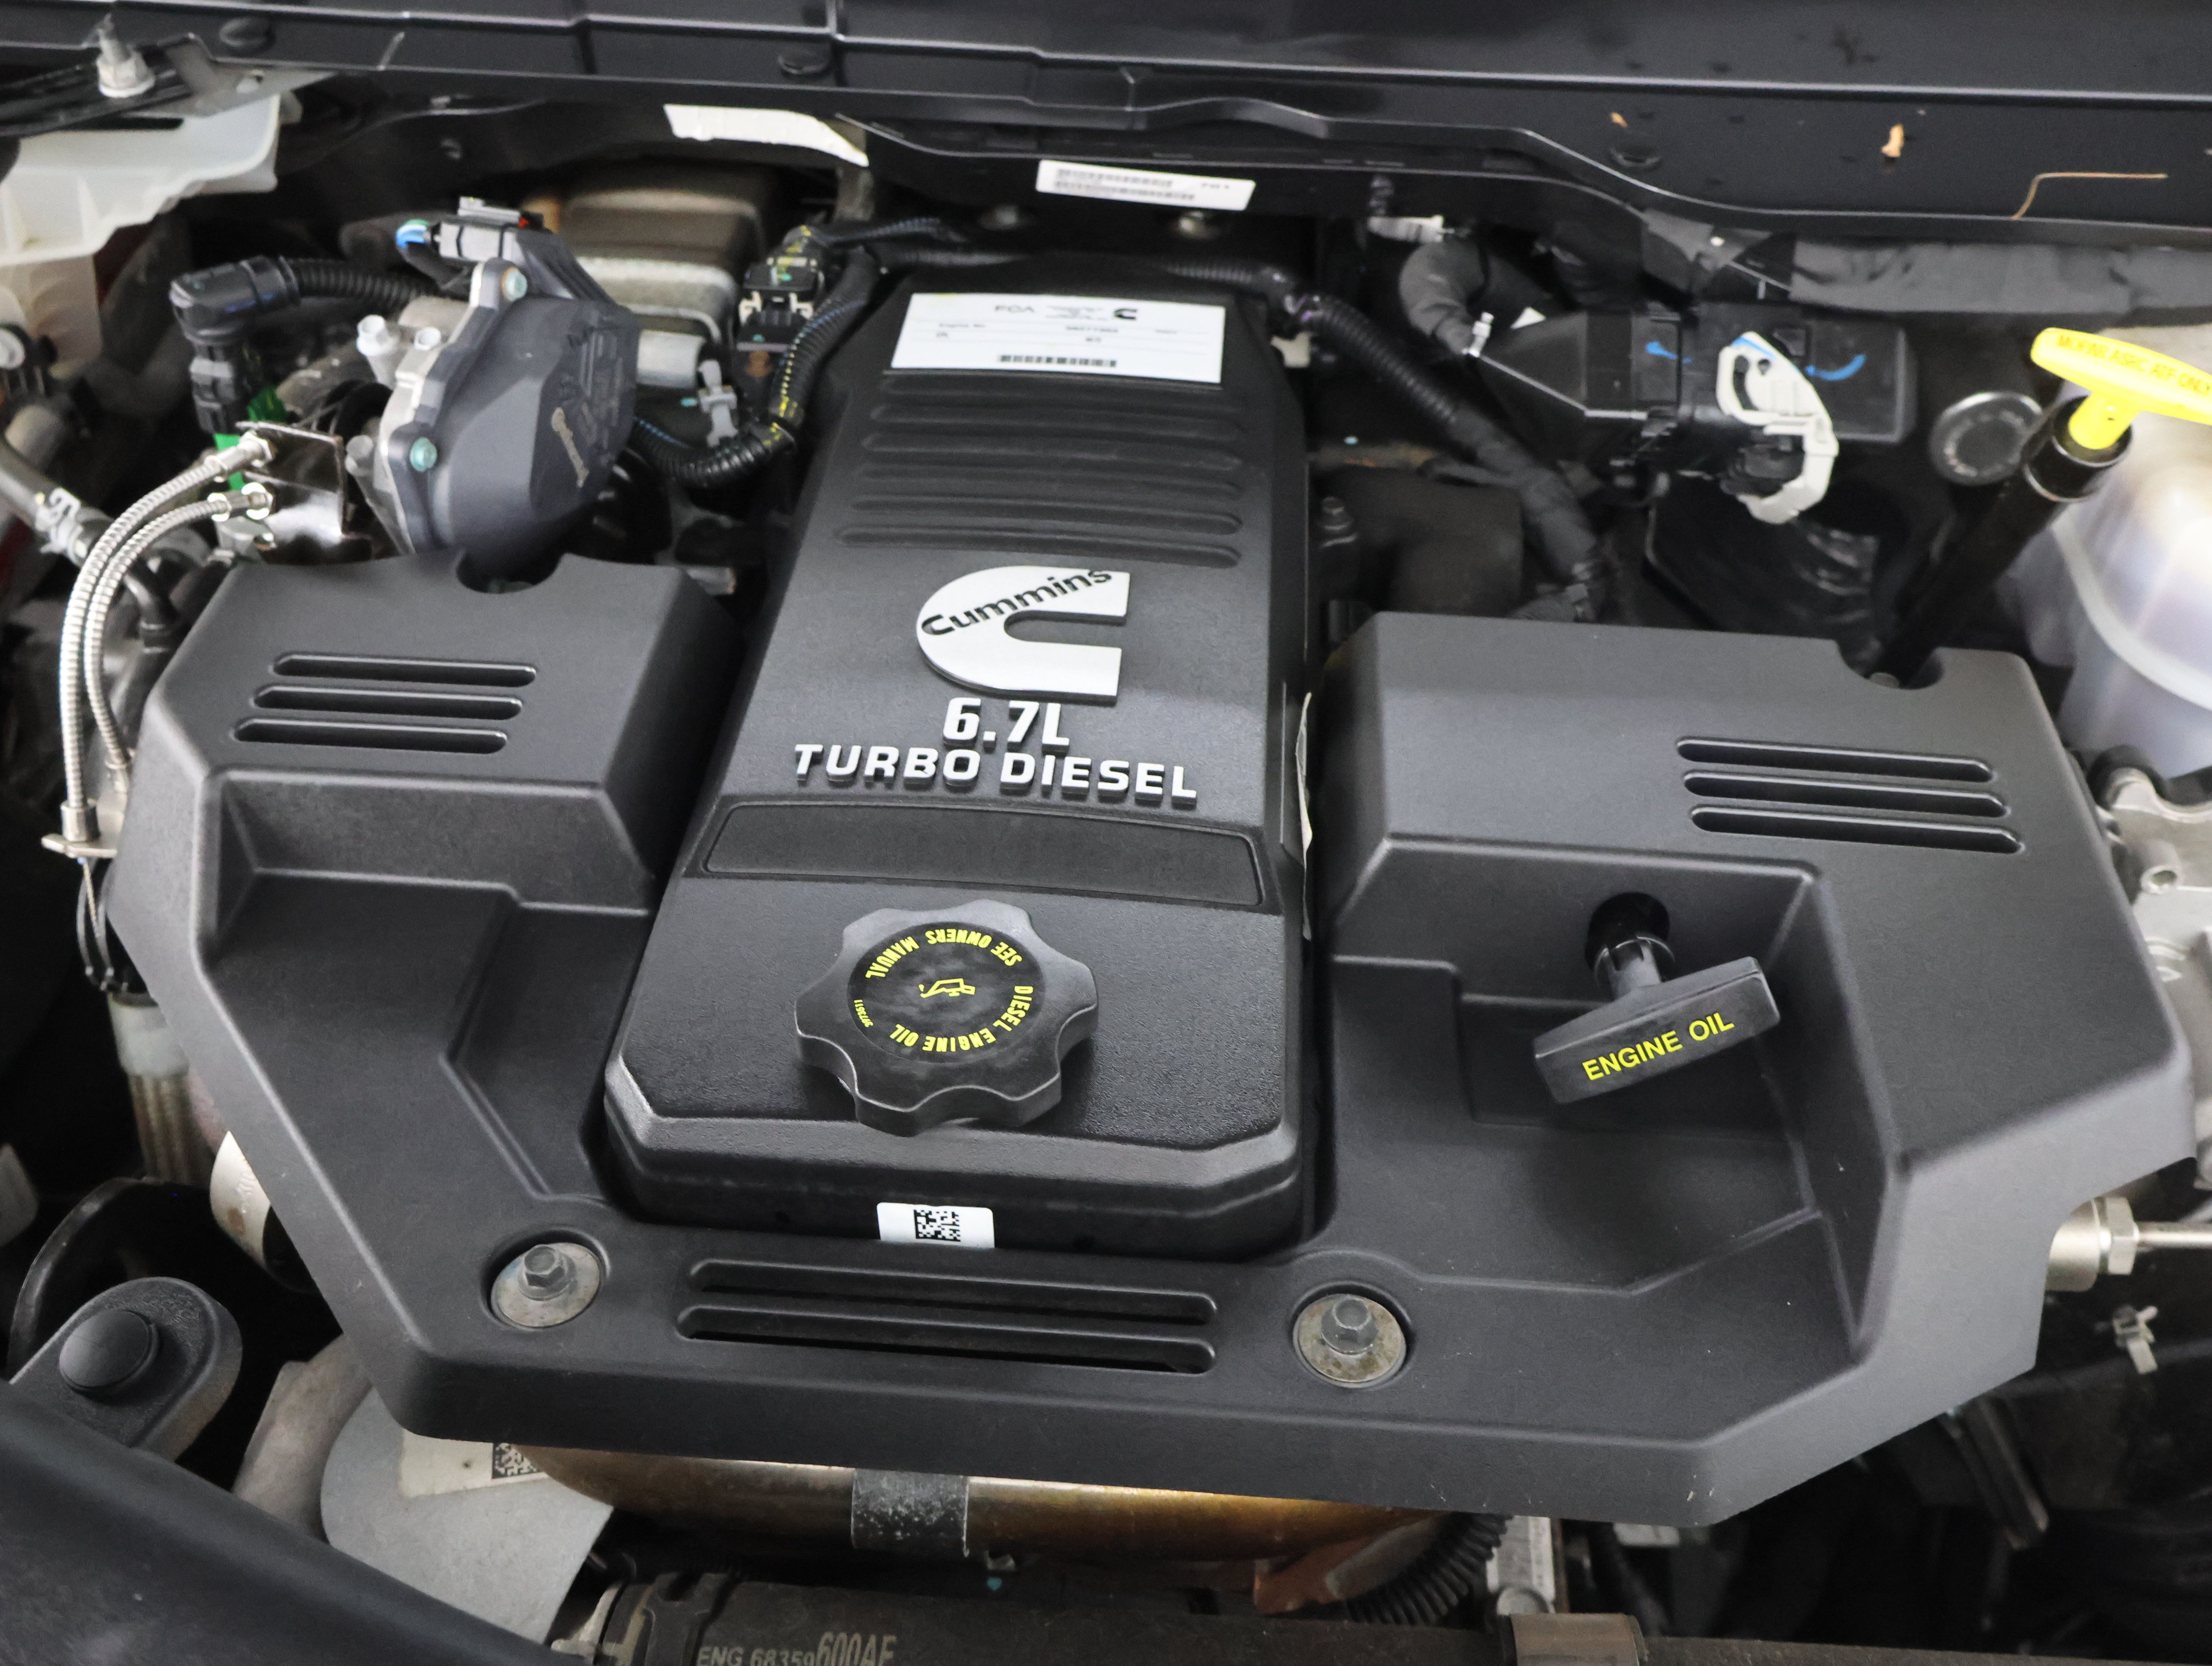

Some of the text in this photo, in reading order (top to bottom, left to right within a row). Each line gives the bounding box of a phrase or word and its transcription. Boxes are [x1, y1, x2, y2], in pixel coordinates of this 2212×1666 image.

[2057, 334, 2109, 359] MOPAR
[2150, 363, 2177, 381] ATF
[921, 570, 1112, 636] Cummins
[943, 697, 1070, 750] 6.7L
[795, 744, 1197, 805] TURBO DIESEL
[865, 928, 1022, 978] SEE OWNERS MANUAL
[889, 986, 1034, 1052] DIESEL ENGINE OIL
[1582, 1012, 1735, 1080] ENGINE OIL
[697, 1645, 744, 1666] ENG
